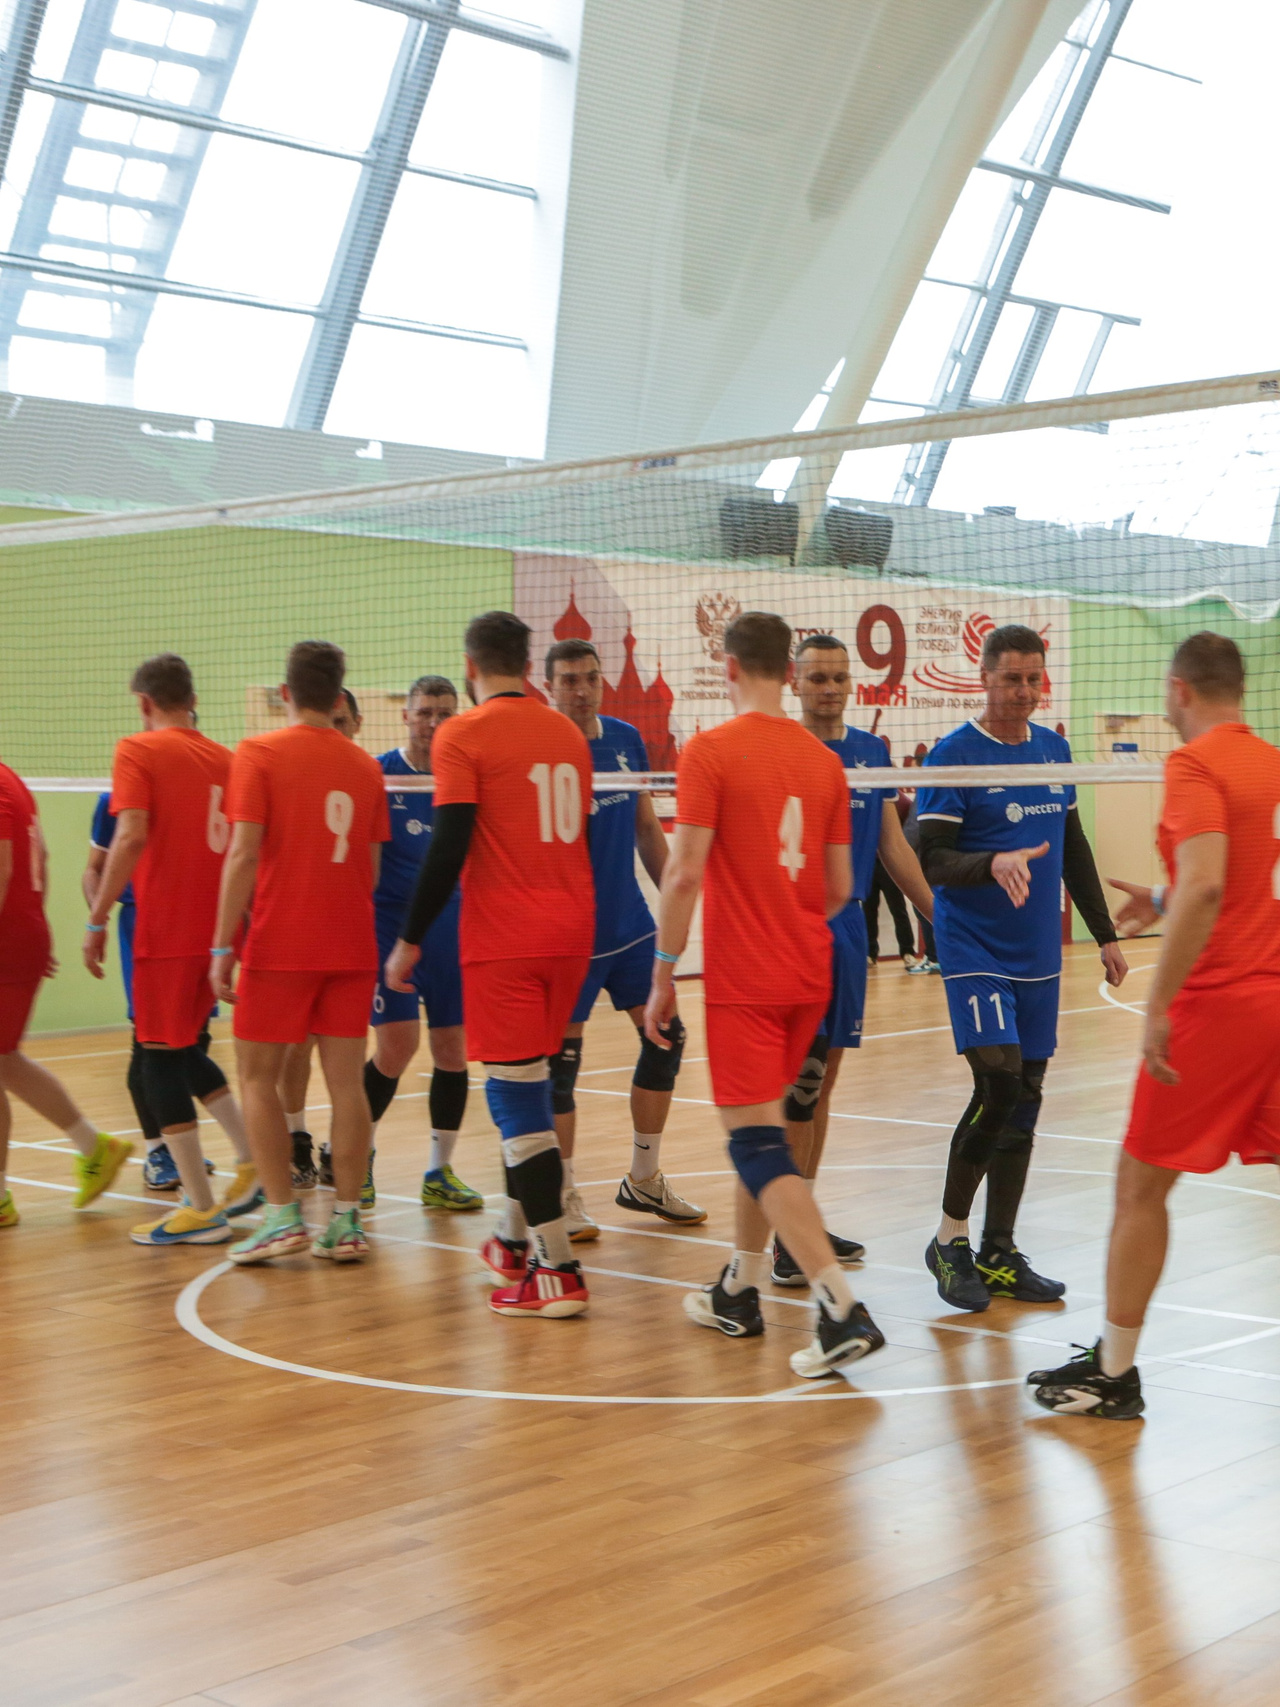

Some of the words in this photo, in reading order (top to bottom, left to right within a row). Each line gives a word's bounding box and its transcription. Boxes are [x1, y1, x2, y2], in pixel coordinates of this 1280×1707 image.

[915, 622, 960, 636] ВЕЛИКОЙ
[919, 606, 962, 620] ЭНЕРГИЯ
[856, 604, 907, 690] 9
[917, 639, 958, 653] ПОБЕДЫ
[947, 697, 960, 709] ПО
[206, 784, 230, 854] 6
[527, 762, 582, 844] 10
[1023, 803, 1062, 816] РОССЕТИ
[324, 789, 355, 864] 9
[778, 794, 807, 883] 4
[968, 992, 1005, 1033] 11
